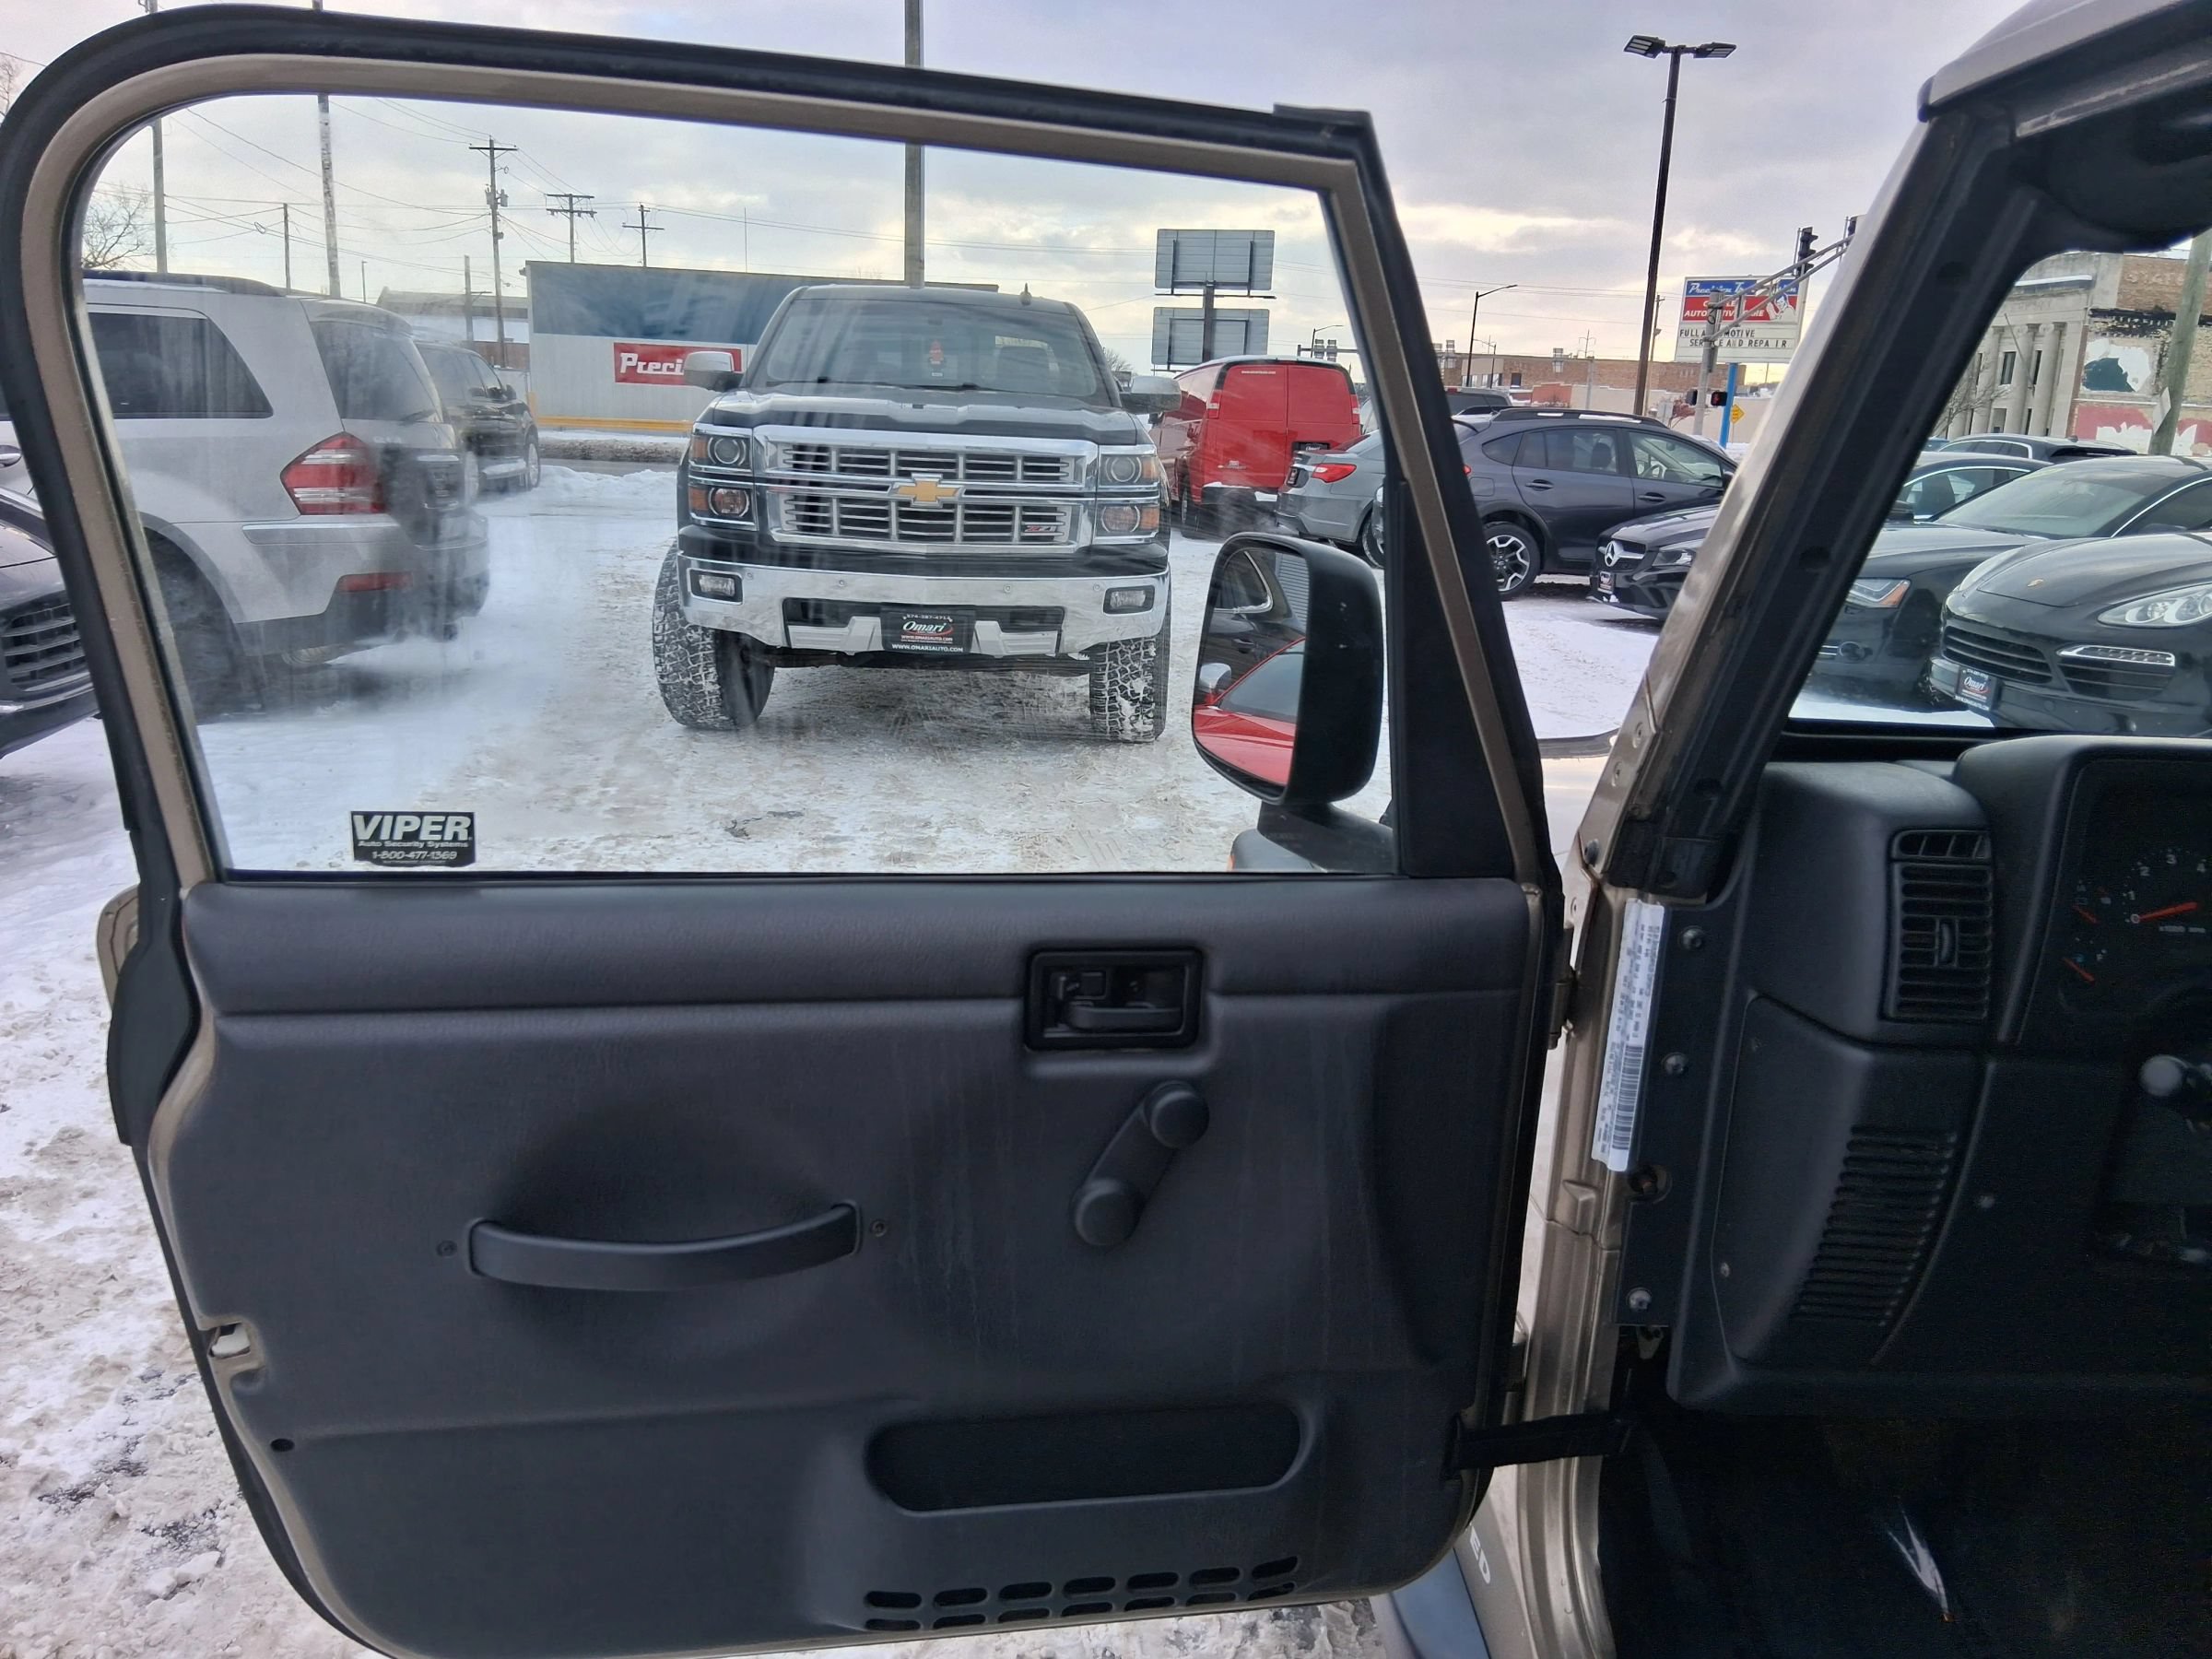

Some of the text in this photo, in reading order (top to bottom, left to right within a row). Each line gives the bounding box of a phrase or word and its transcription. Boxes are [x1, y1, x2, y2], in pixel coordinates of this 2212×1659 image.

[1688, 283, 1733, 293] Precon
[1680, 328, 1755, 338] FULL AMOTIVE
[1689, 338, 1724, 347] SERCE
[619, 352, 685, 376] Preci
[903, 621, 947, 631] Omari
[352, 815, 472, 841] VIPER
[384, 840, 425, 849] Security
[372, 851, 457, 859] 1-800-477-1369
